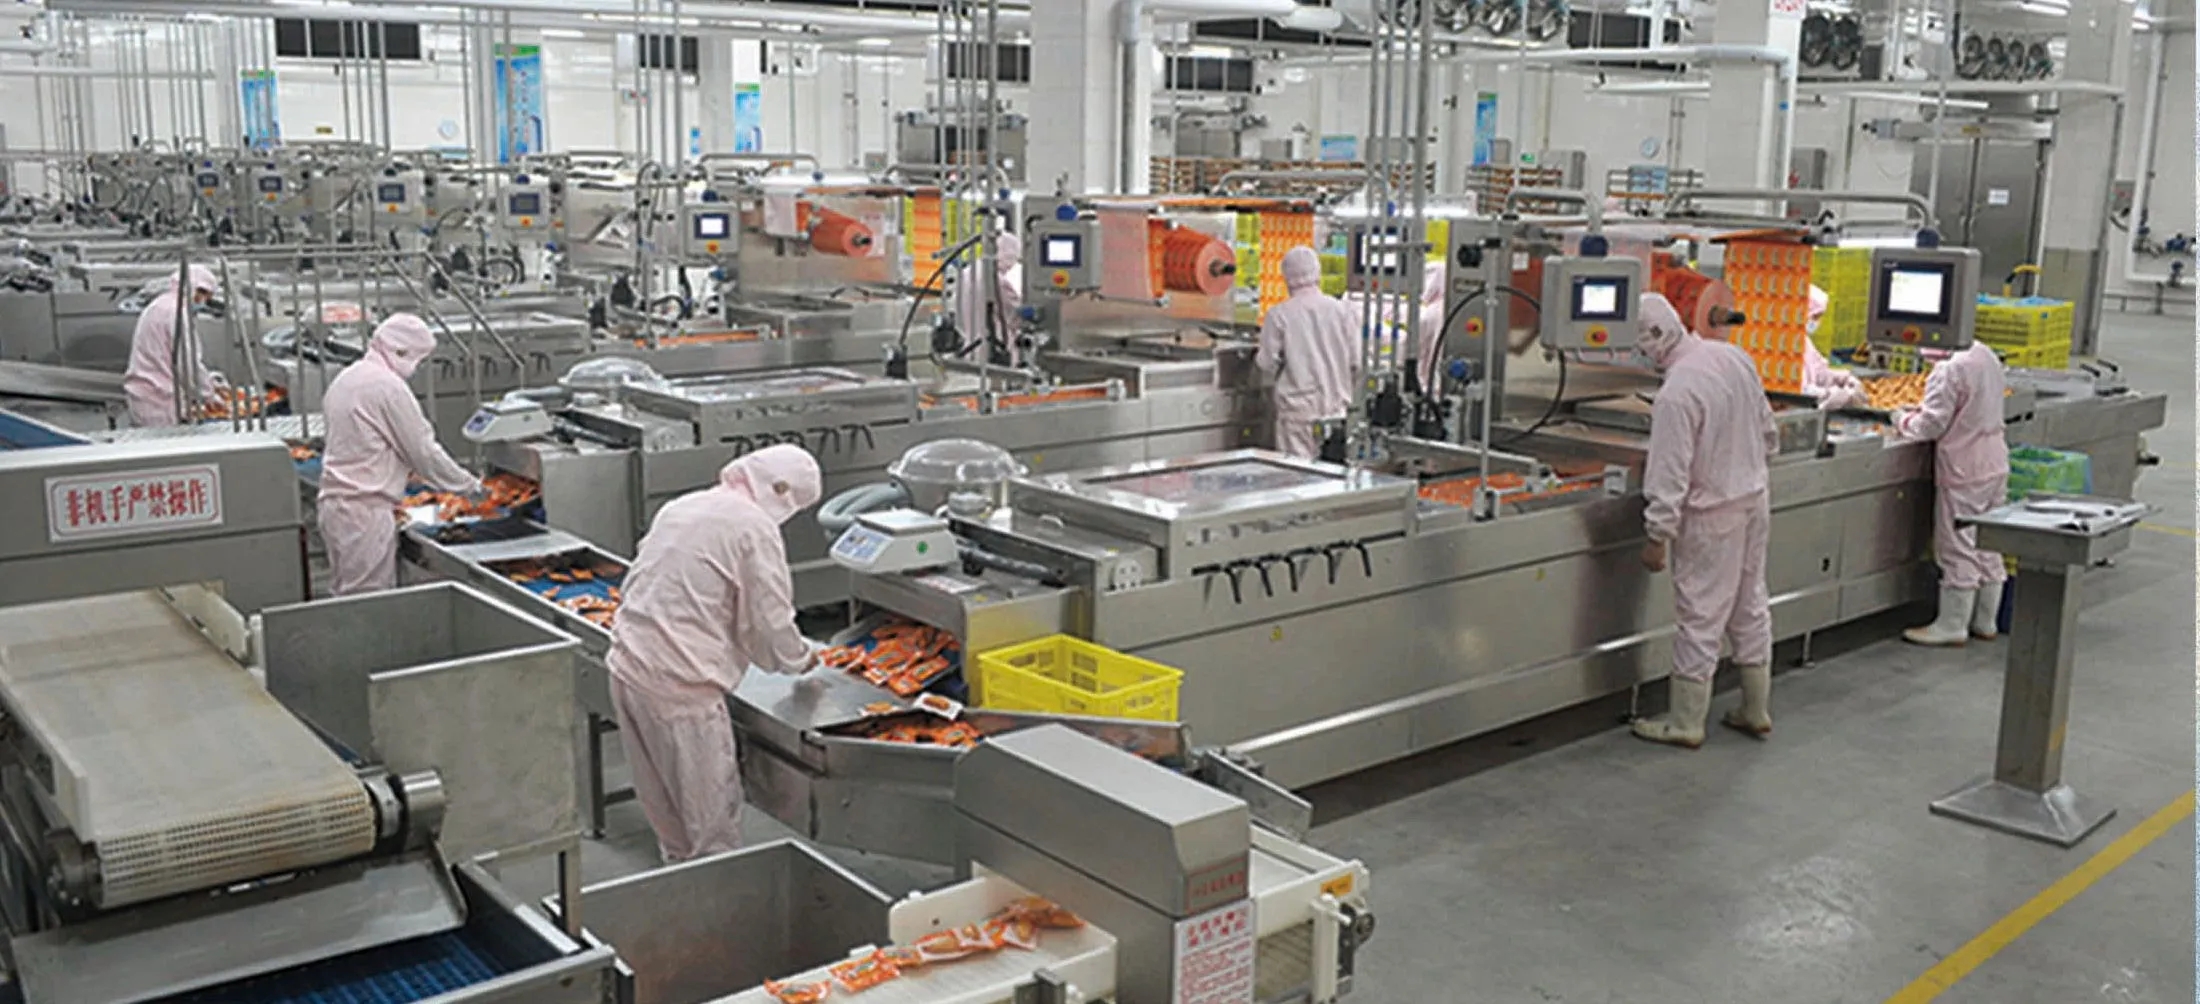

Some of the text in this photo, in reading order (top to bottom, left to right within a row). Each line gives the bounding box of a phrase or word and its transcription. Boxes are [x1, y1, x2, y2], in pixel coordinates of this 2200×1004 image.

[66, 478, 206, 527] 非机手严禁操作
